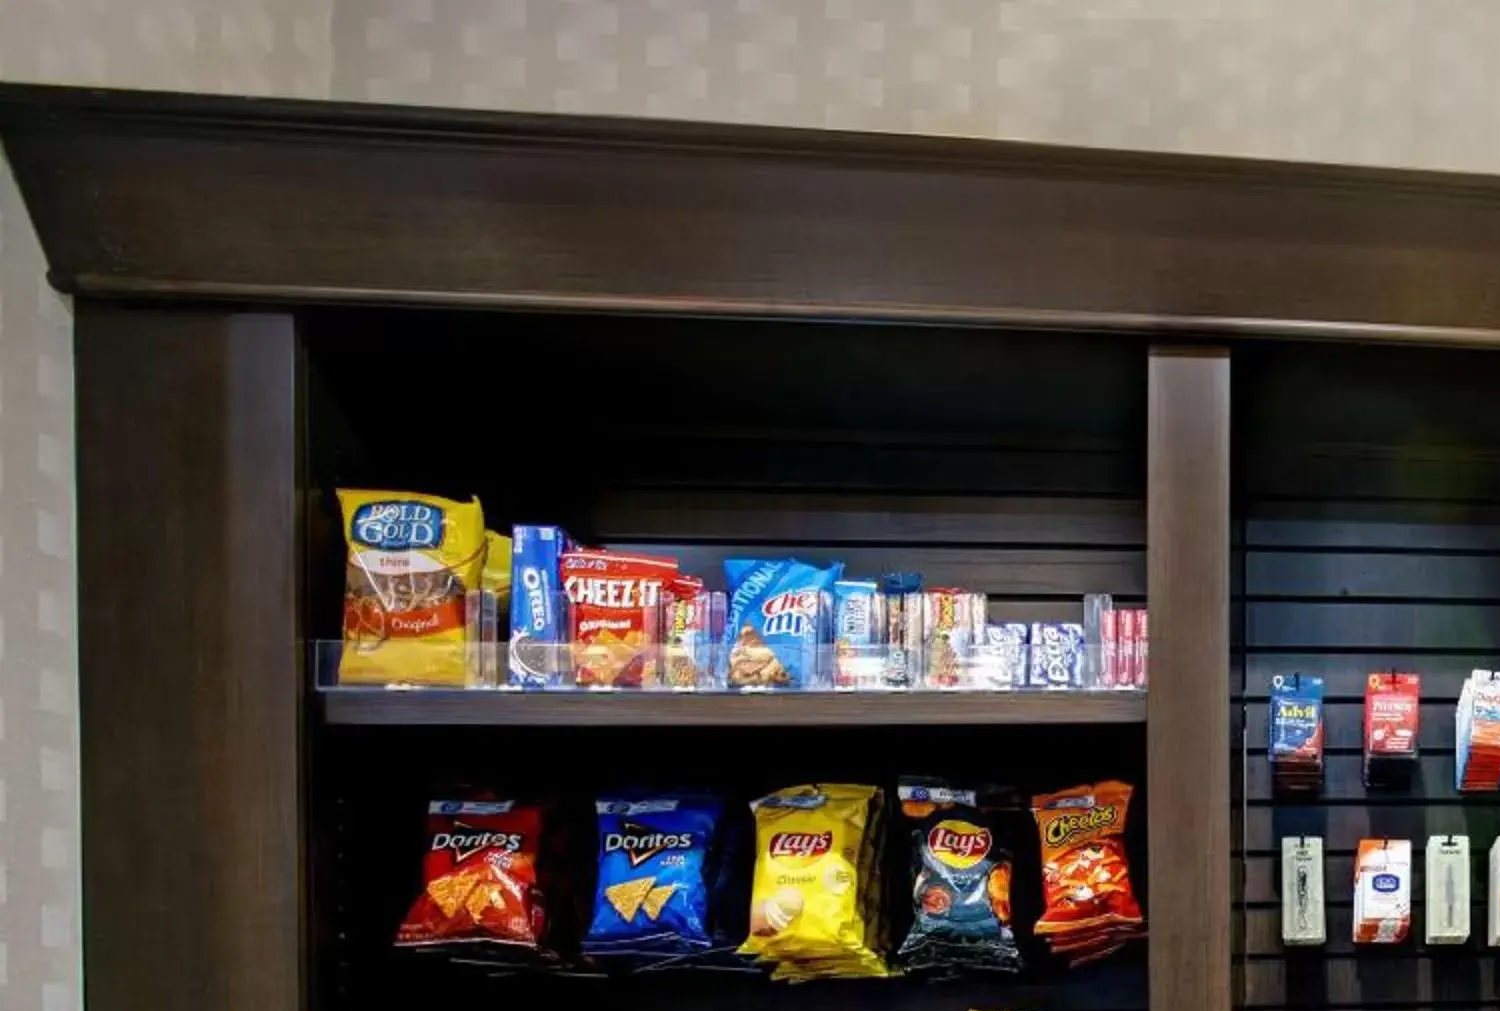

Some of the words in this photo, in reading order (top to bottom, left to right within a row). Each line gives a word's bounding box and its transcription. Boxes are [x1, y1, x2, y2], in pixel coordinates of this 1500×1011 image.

[360, 521, 433, 544] GOLD
[522, 567, 546, 631] OREO
[391, 614, 440, 632] Original
[1044, 806, 1118, 847] Cheetos
[430, 832, 522, 851] Doritos
[604, 832, 693, 852] Doritos
